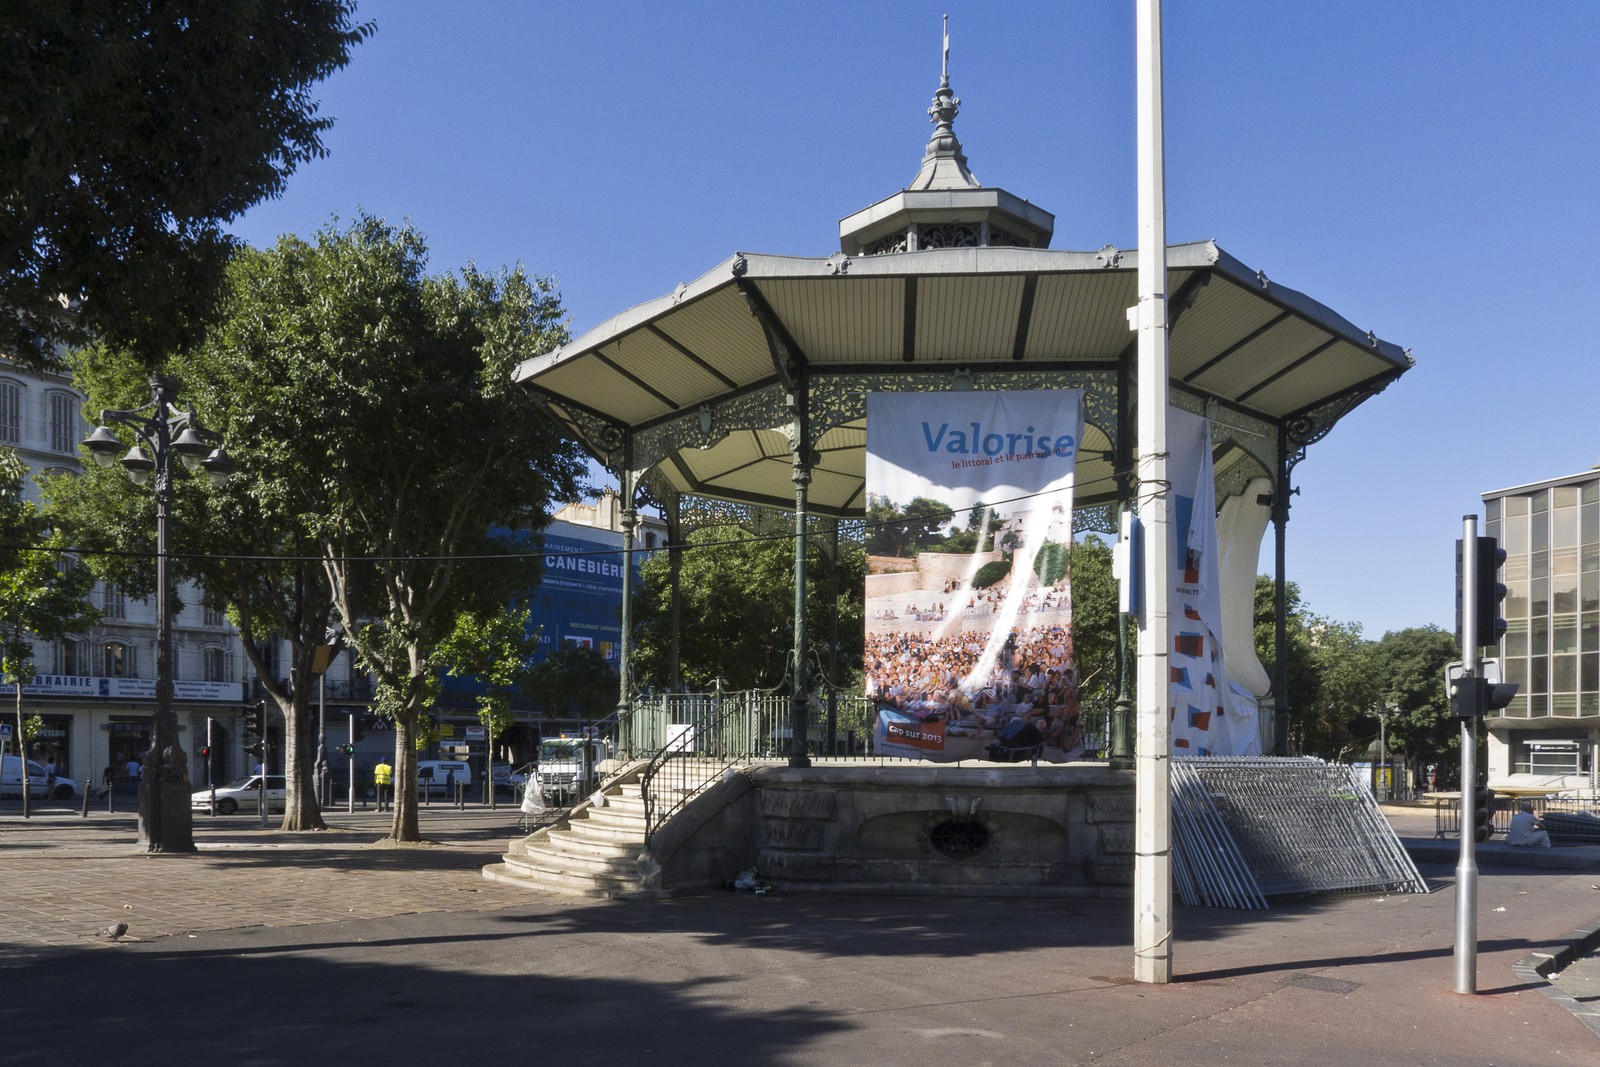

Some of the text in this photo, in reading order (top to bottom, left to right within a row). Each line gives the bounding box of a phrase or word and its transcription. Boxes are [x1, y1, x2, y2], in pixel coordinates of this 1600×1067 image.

[921, 421, 1074, 457] Valorise
[952, 446, 1066, 469] le littoral et le patrimoine
[31, 676, 91, 687] BRAIRIE
[888, 725, 942, 744] Cap sur 2013
